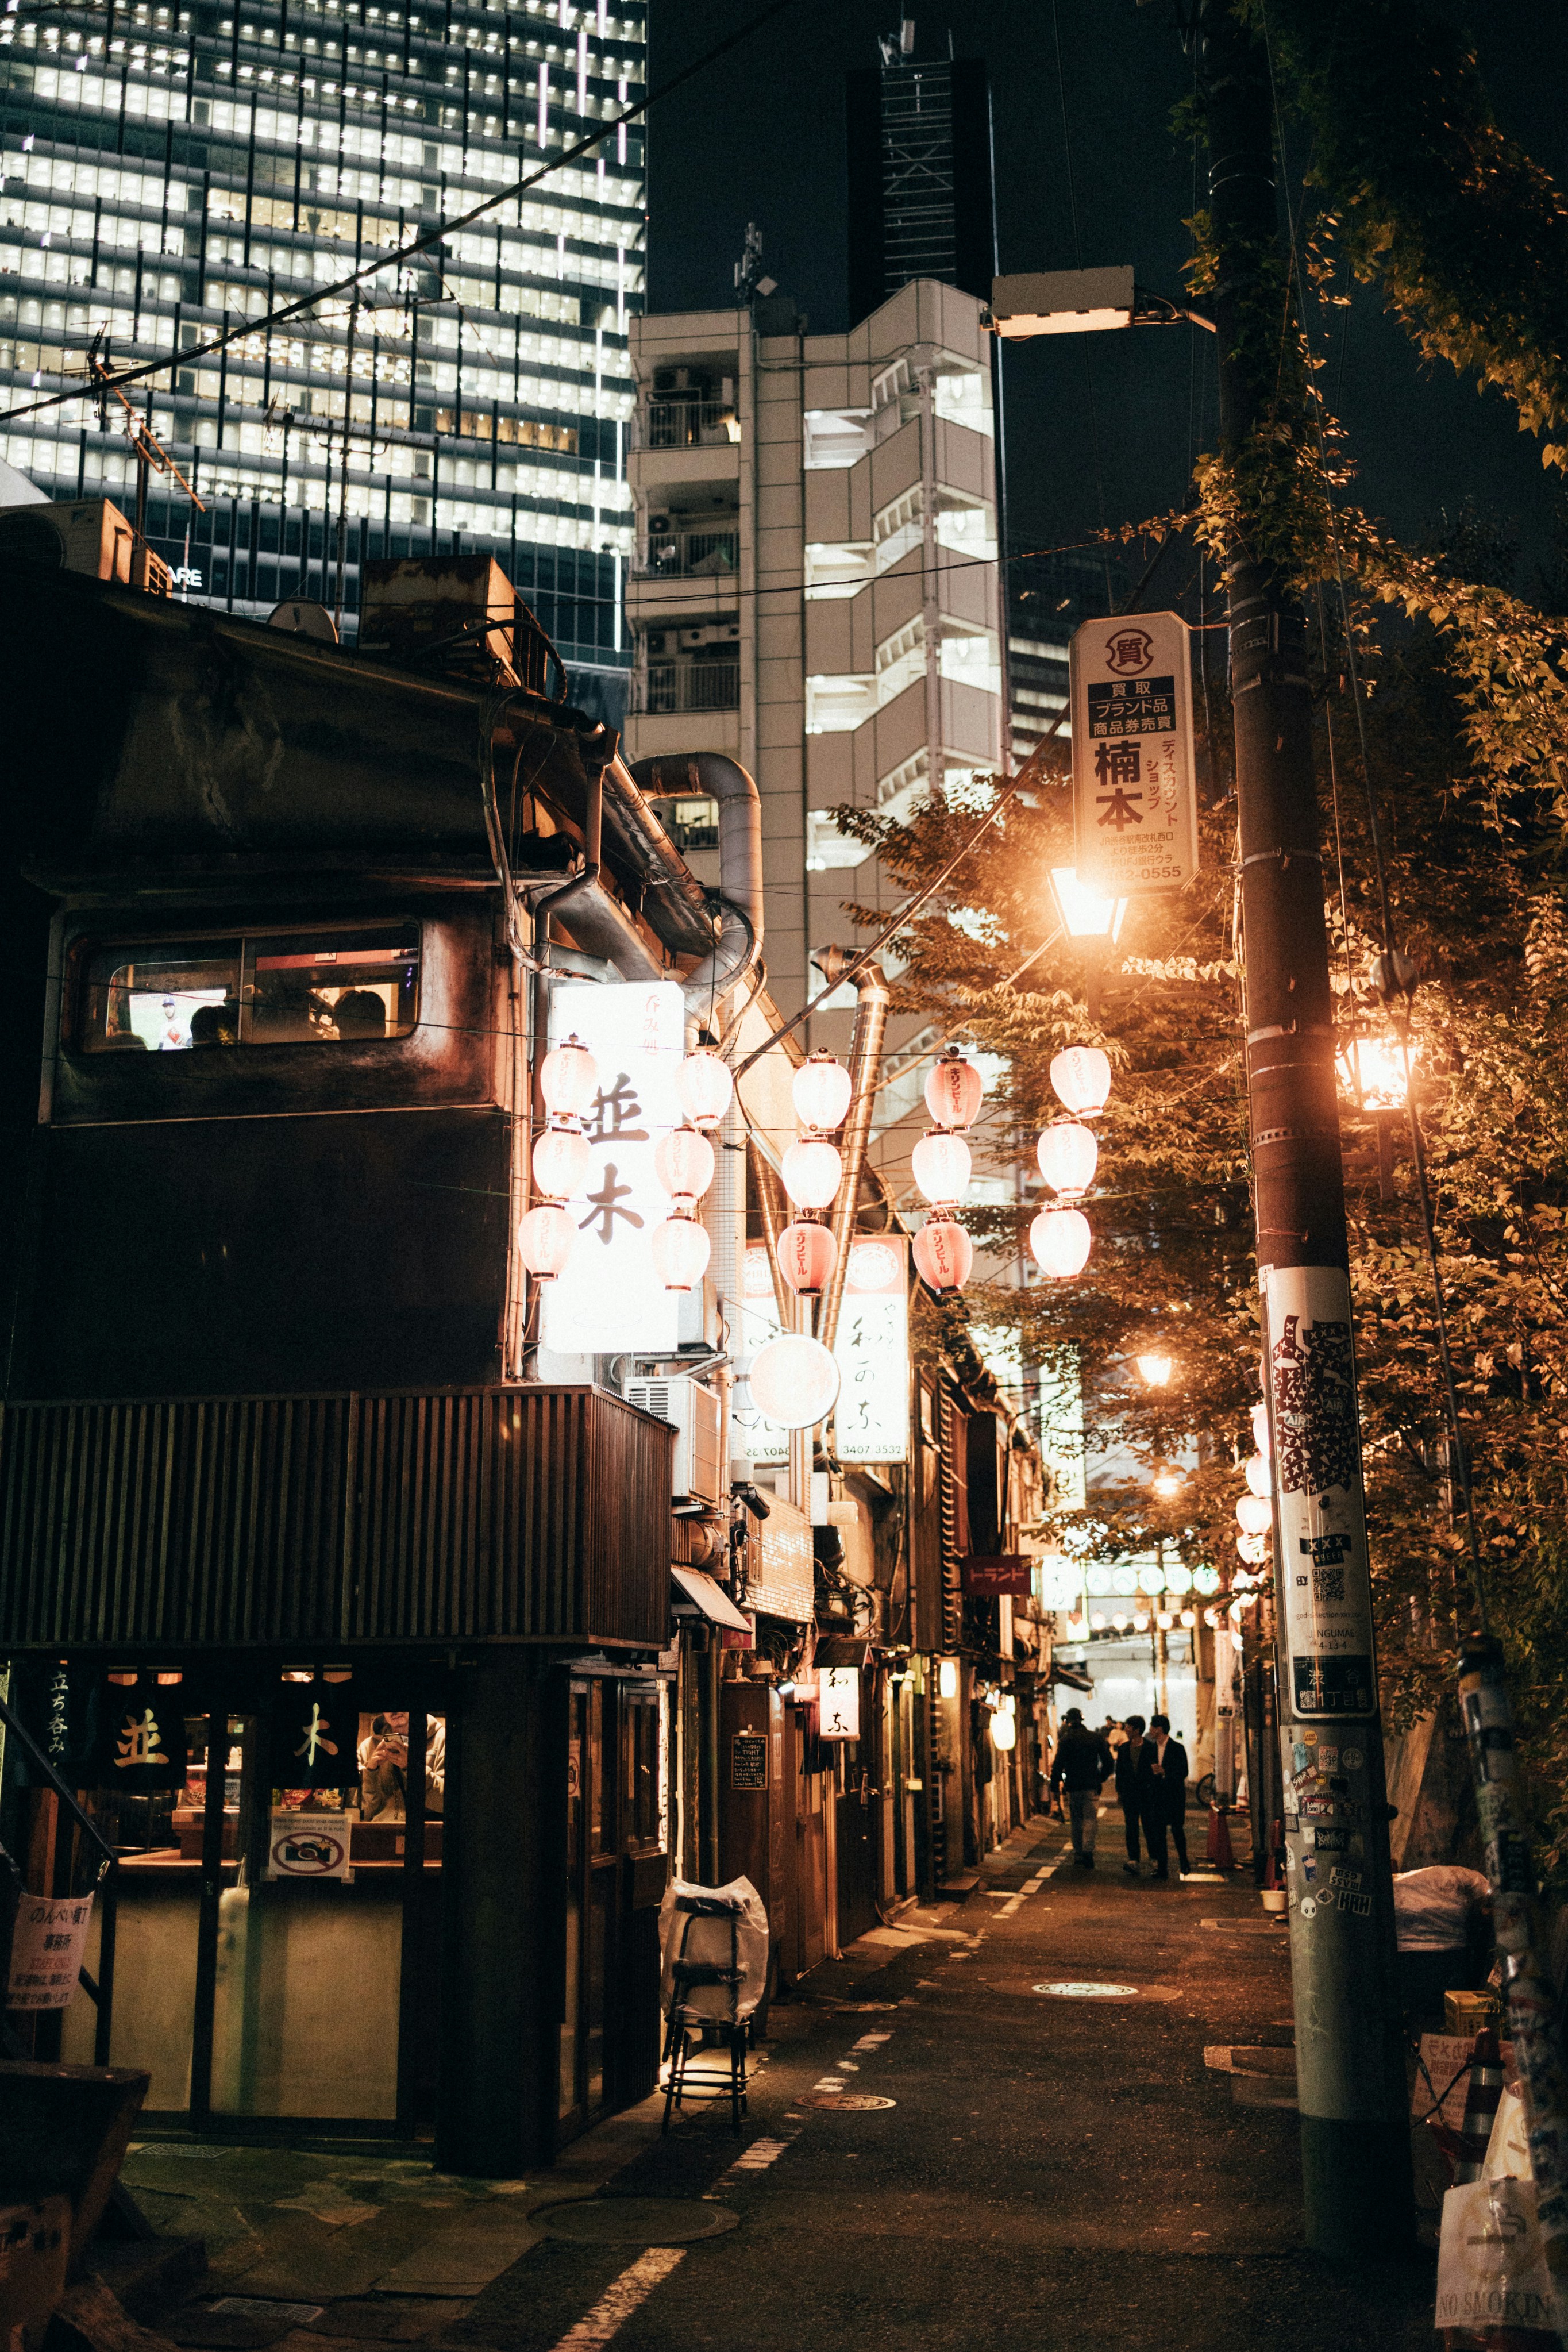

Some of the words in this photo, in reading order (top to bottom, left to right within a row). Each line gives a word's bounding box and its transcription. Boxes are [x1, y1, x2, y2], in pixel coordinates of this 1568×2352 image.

[1117, 638, 1143, 667] 質
[1096, 698, 1168, 718] ブランド品
[1112, 681, 1150, 698] 買取
[1093, 715, 1172, 736] 商品券売買
[1095, 740, 1144, 832] 楠本
[1146, 760, 1161, 810] ショップ
[1162, 740, 1178, 826] ディスカウント
[949, 1066, 960, 1111] キリンビール
[578, 1072, 649, 1245] 並木
[672, 1134, 682, 1179] キリンビール
[539, 1212, 550, 1260] キリンビール
[796, 1229, 807, 1276] キリンビール
[931, 1222, 947, 1267] キリンビール
[843, 1445, 870, 1454] 3407
[874, 1445, 901, 1454] 3532
[1320, 1551, 1343, 1562] BEER
[1308, 1629, 1355, 1638] JNGUMAE
[1319, 1641, 1347, 1650] 4-13-4
[1308, 1668, 1360, 1685] 渋谷
[46, 1670, 68, 1768] 立ち呑み
[114, 1708, 169, 1768] 並
[293, 1703, 338, 1766] 木
[1439, 2294, 1458, 2318] NO
[1464, 2291, 1550, 2318] SMOKIN
